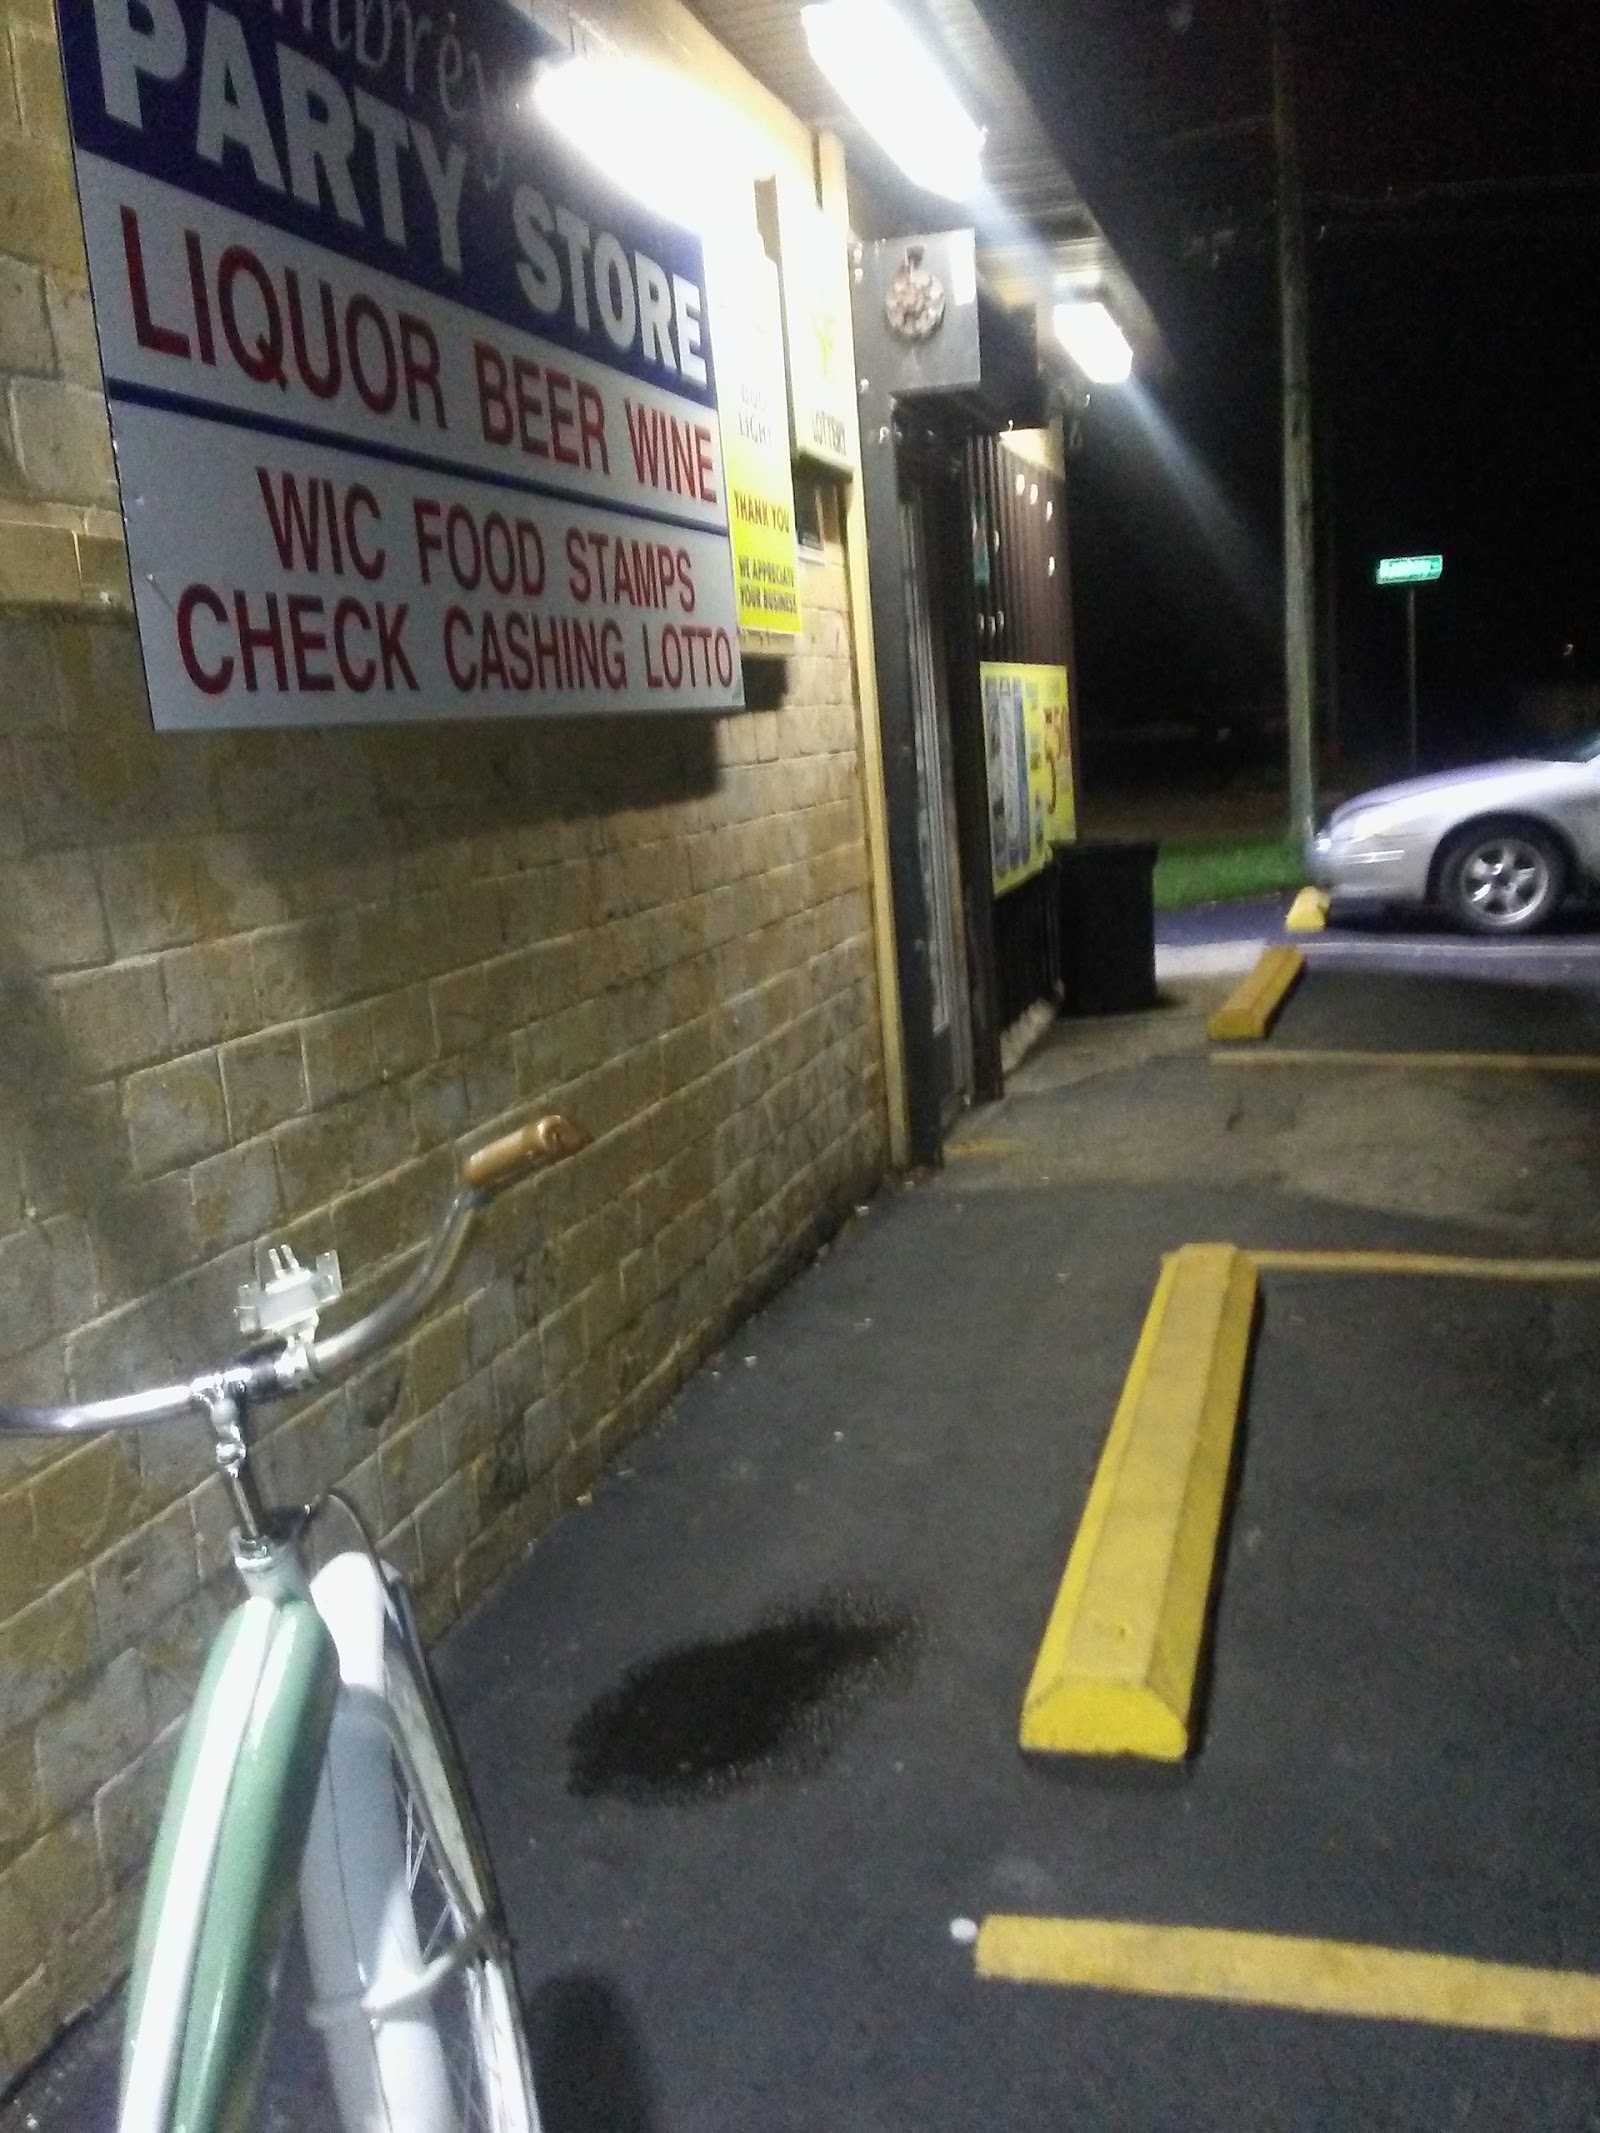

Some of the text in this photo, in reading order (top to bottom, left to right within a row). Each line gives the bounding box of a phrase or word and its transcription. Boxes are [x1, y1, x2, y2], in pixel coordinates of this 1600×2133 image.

[93, 0, 709, 387] PARTY STORE
[120, 205, 718, 504] LIQUOR BEER WINE
[256, 466, 696, 613] WIC FOOD STAMPS
[733, 489, 790, 534] THANK YOU
[177, 583, 733, 695] CHECK CASHING LOTTO
